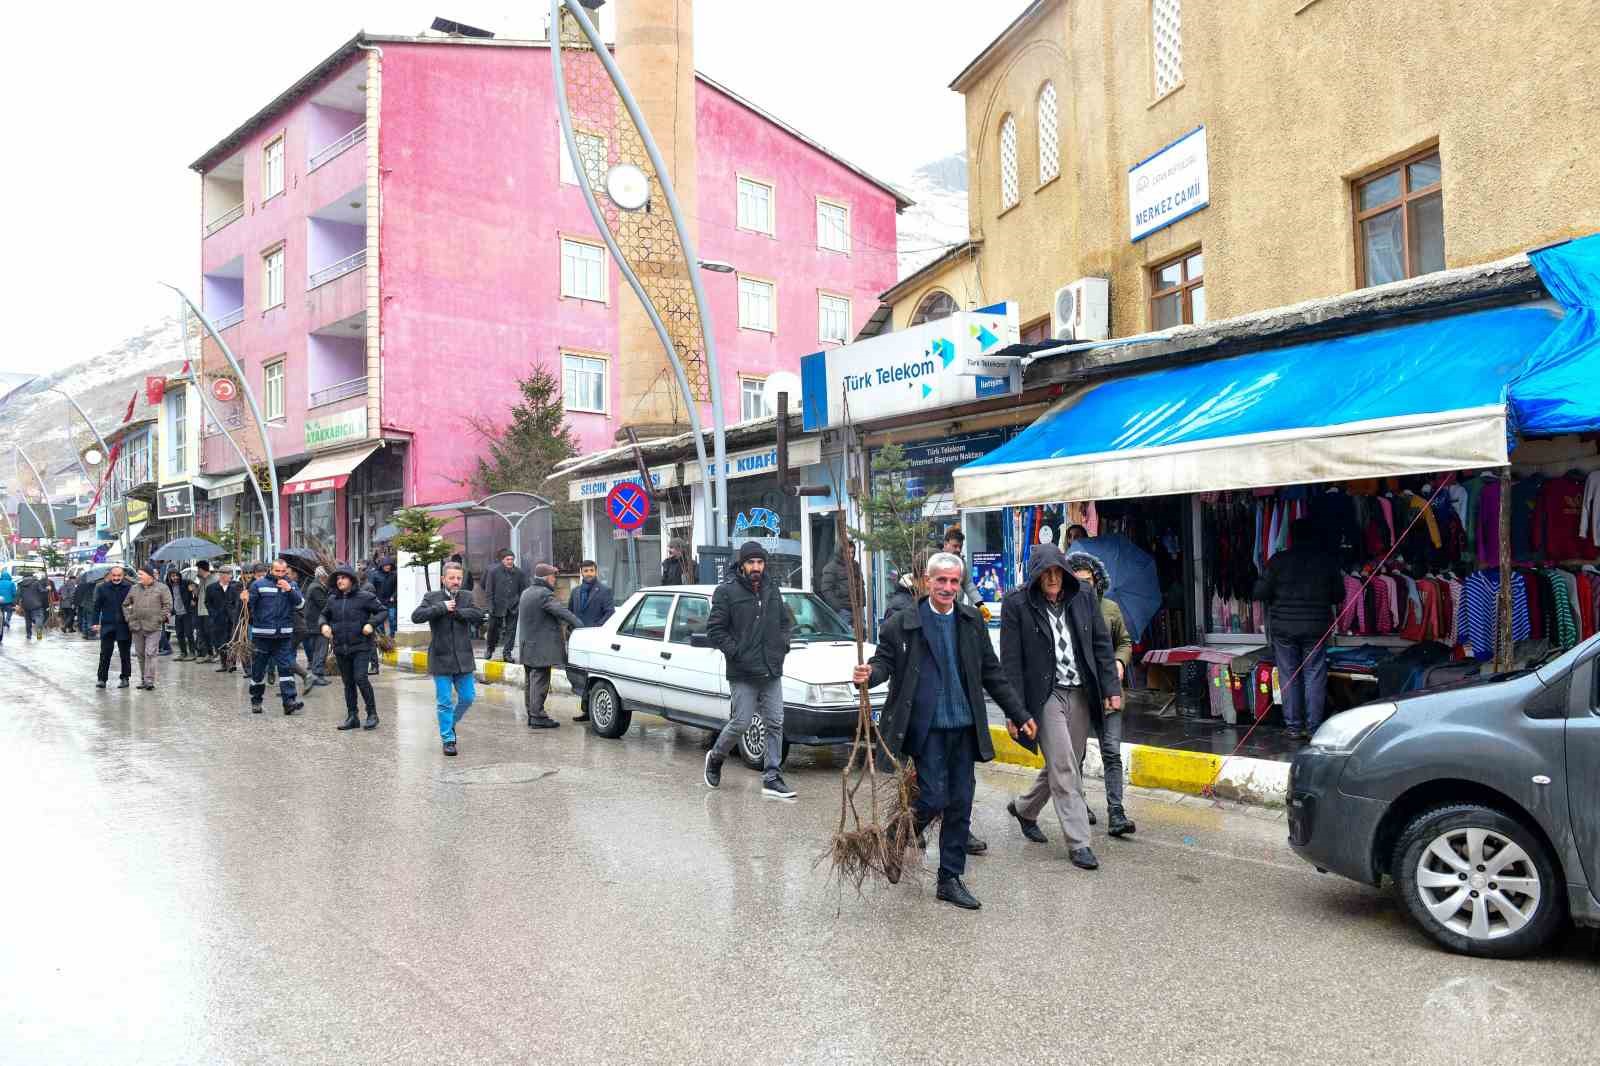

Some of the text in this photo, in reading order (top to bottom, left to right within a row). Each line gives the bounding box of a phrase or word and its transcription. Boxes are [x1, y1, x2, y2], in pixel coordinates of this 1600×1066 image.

[1136, 197, 1172, 226] MERKEZ
[844, 359, 934, 393] Türk Telekom
[736, 448, 778, 472] KUAFÖ
[941, 444, 966, 454] Telekom
